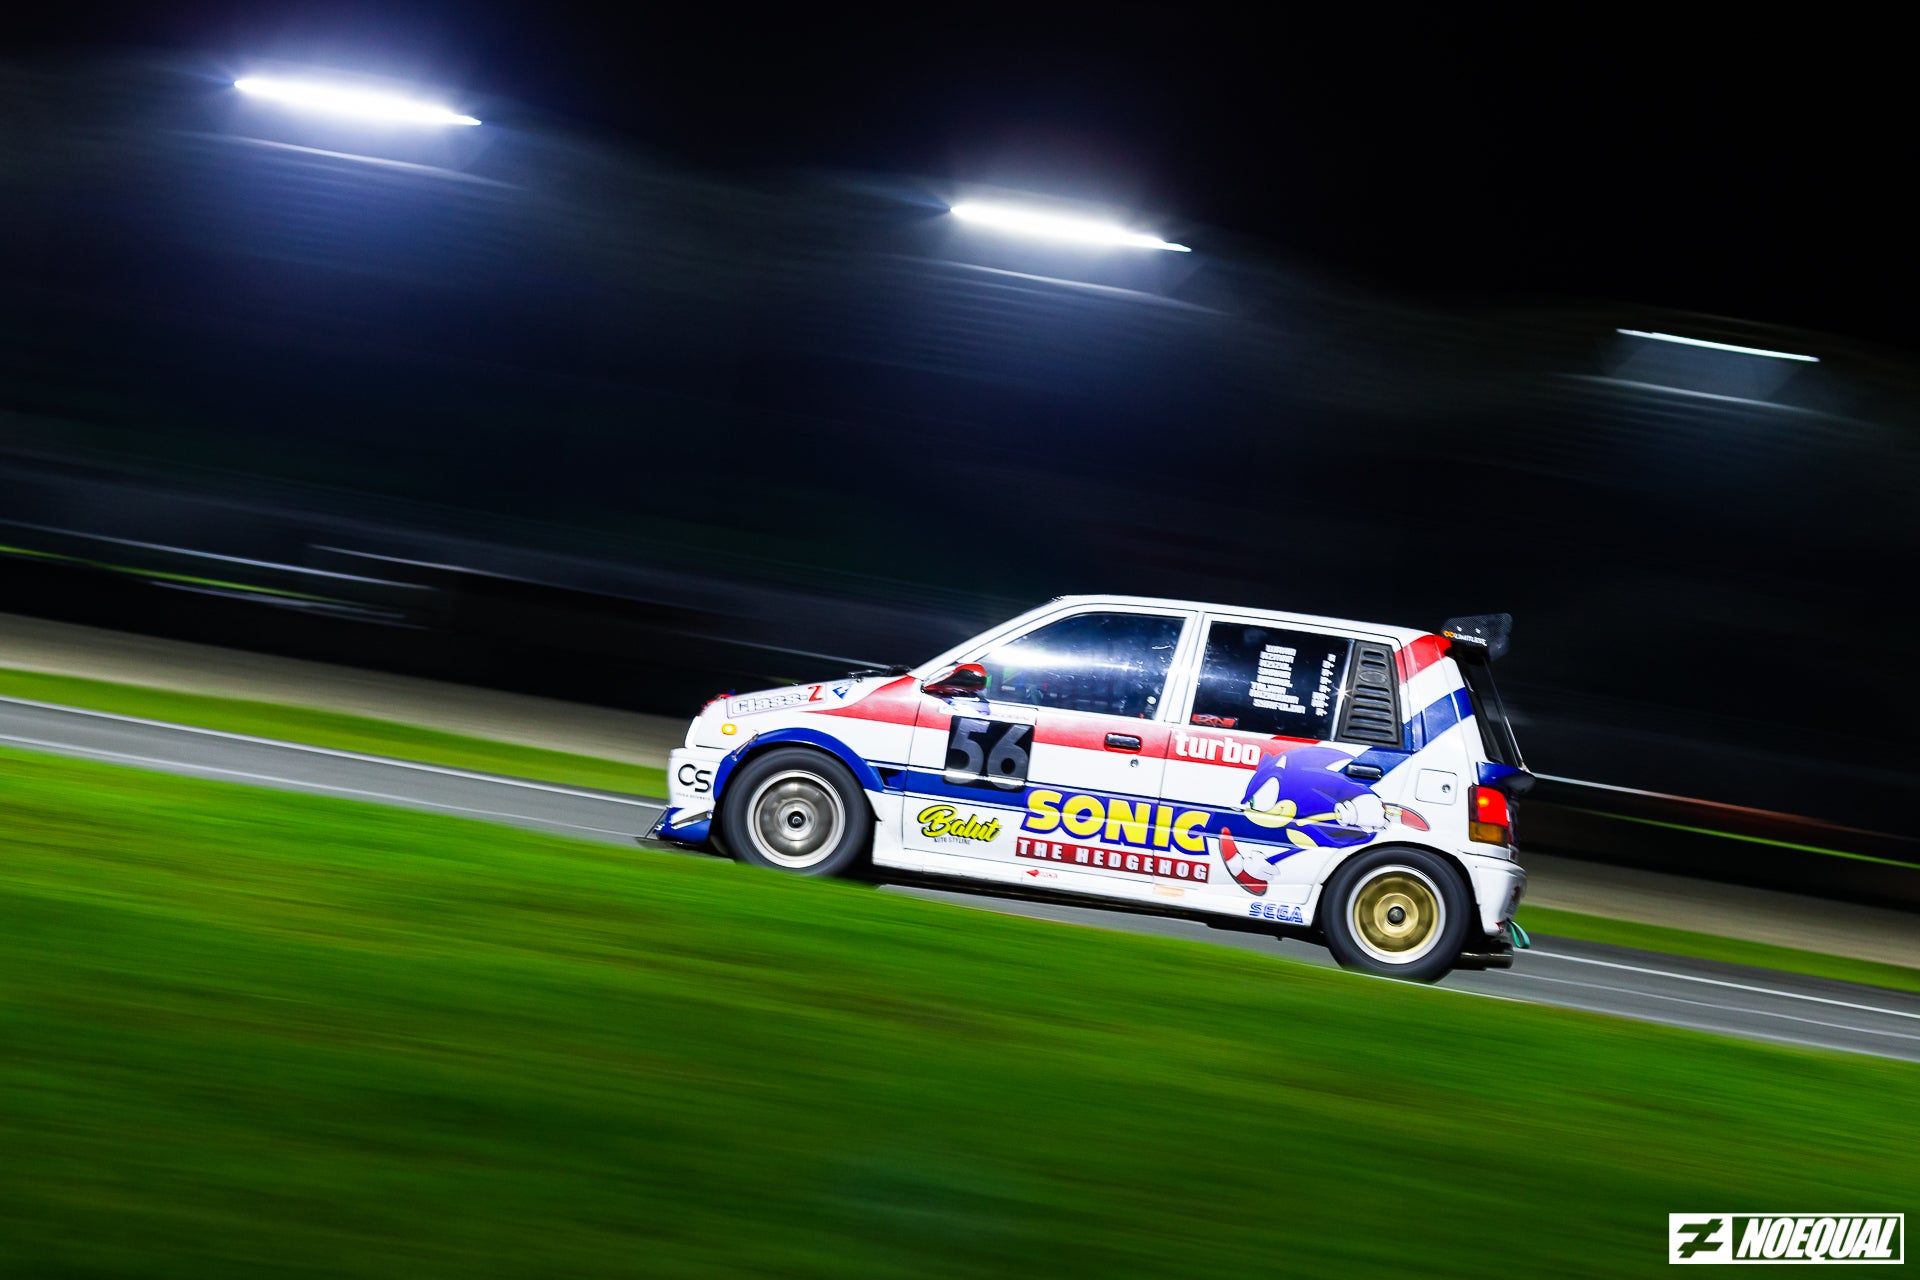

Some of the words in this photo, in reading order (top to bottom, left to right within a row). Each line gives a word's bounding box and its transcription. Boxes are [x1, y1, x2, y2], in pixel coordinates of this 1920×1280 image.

[944, 717, 1029, 790] 56
[1174, 731, 1260, 766] turbo
[678, 763, 712, 793] CS
[917, 804, 1003, 842] Balut
[1024, 789, 1211, 853] SONIC
[1019, 839, 1063, 860] THE
[1075, 846, 1207, 881] HEDGEHOG
[1249, 901, 1304, 923] SEGA
